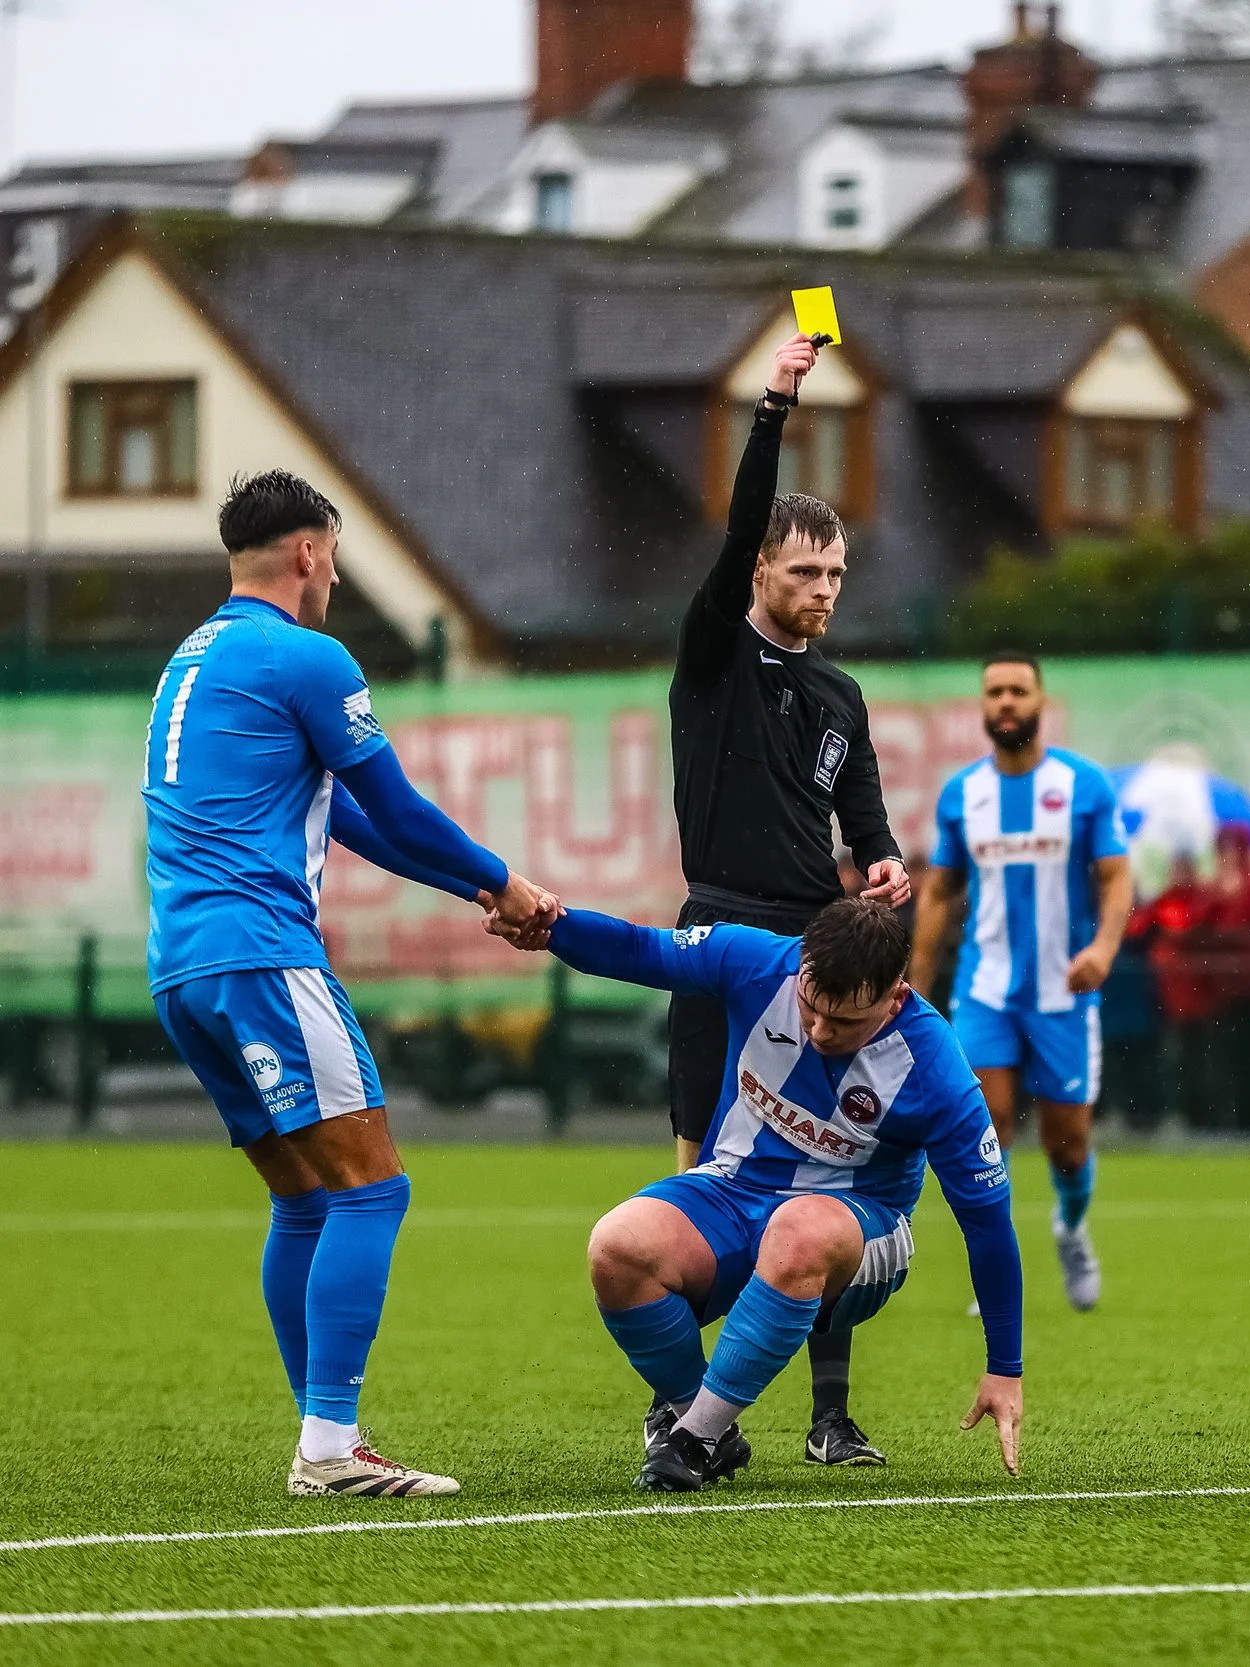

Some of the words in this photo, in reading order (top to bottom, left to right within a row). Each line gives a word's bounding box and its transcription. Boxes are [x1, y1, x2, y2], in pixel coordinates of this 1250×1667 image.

[144, 665, 200, 787] 11
[277, 1082, 306, 1099] ADVICE
[268, 1098, 296, 1115] RVICES
[740, 1069, 867, 1157] STUART
[779, 1124, 812, 1147] HEATING
[812, 1143, 852, 1161] SUPPLIES
[988, 1180, 994, 1188] &
